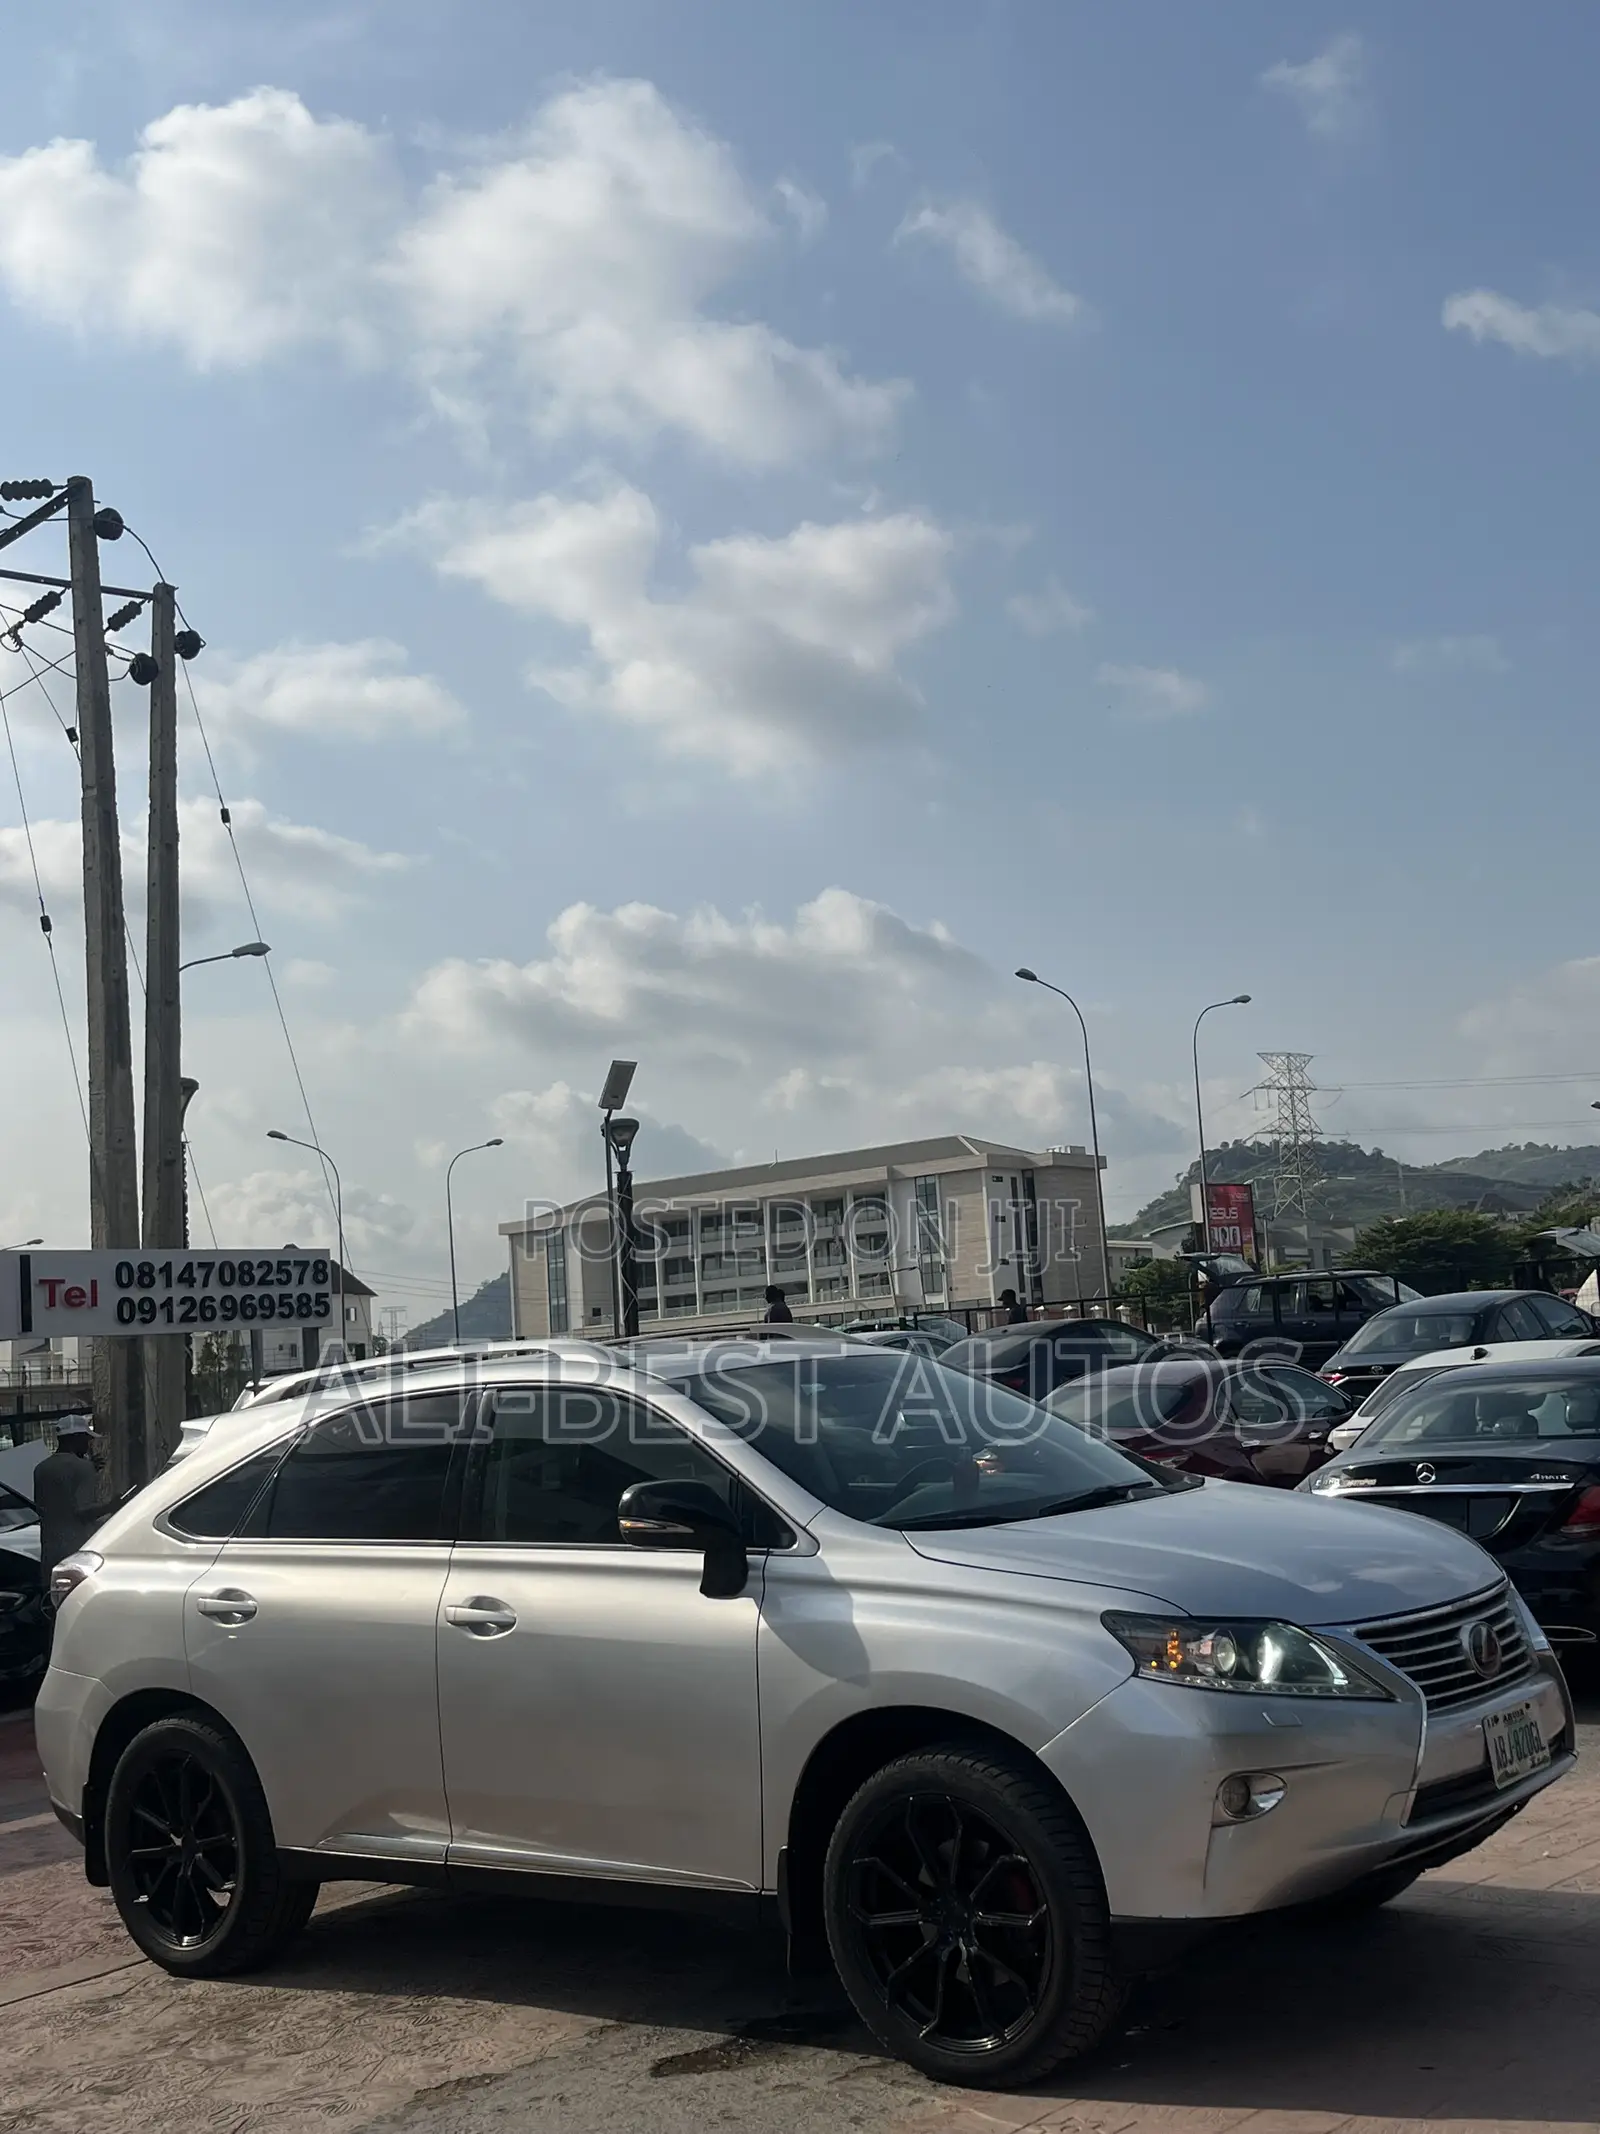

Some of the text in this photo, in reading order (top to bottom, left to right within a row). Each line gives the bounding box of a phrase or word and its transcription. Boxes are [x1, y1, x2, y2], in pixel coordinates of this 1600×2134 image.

[114, 1258, 329, 1289] 08147082578
[38, 1278, 98, 1309] Tel
[116, 1292, 331, 1325] 09126969585
